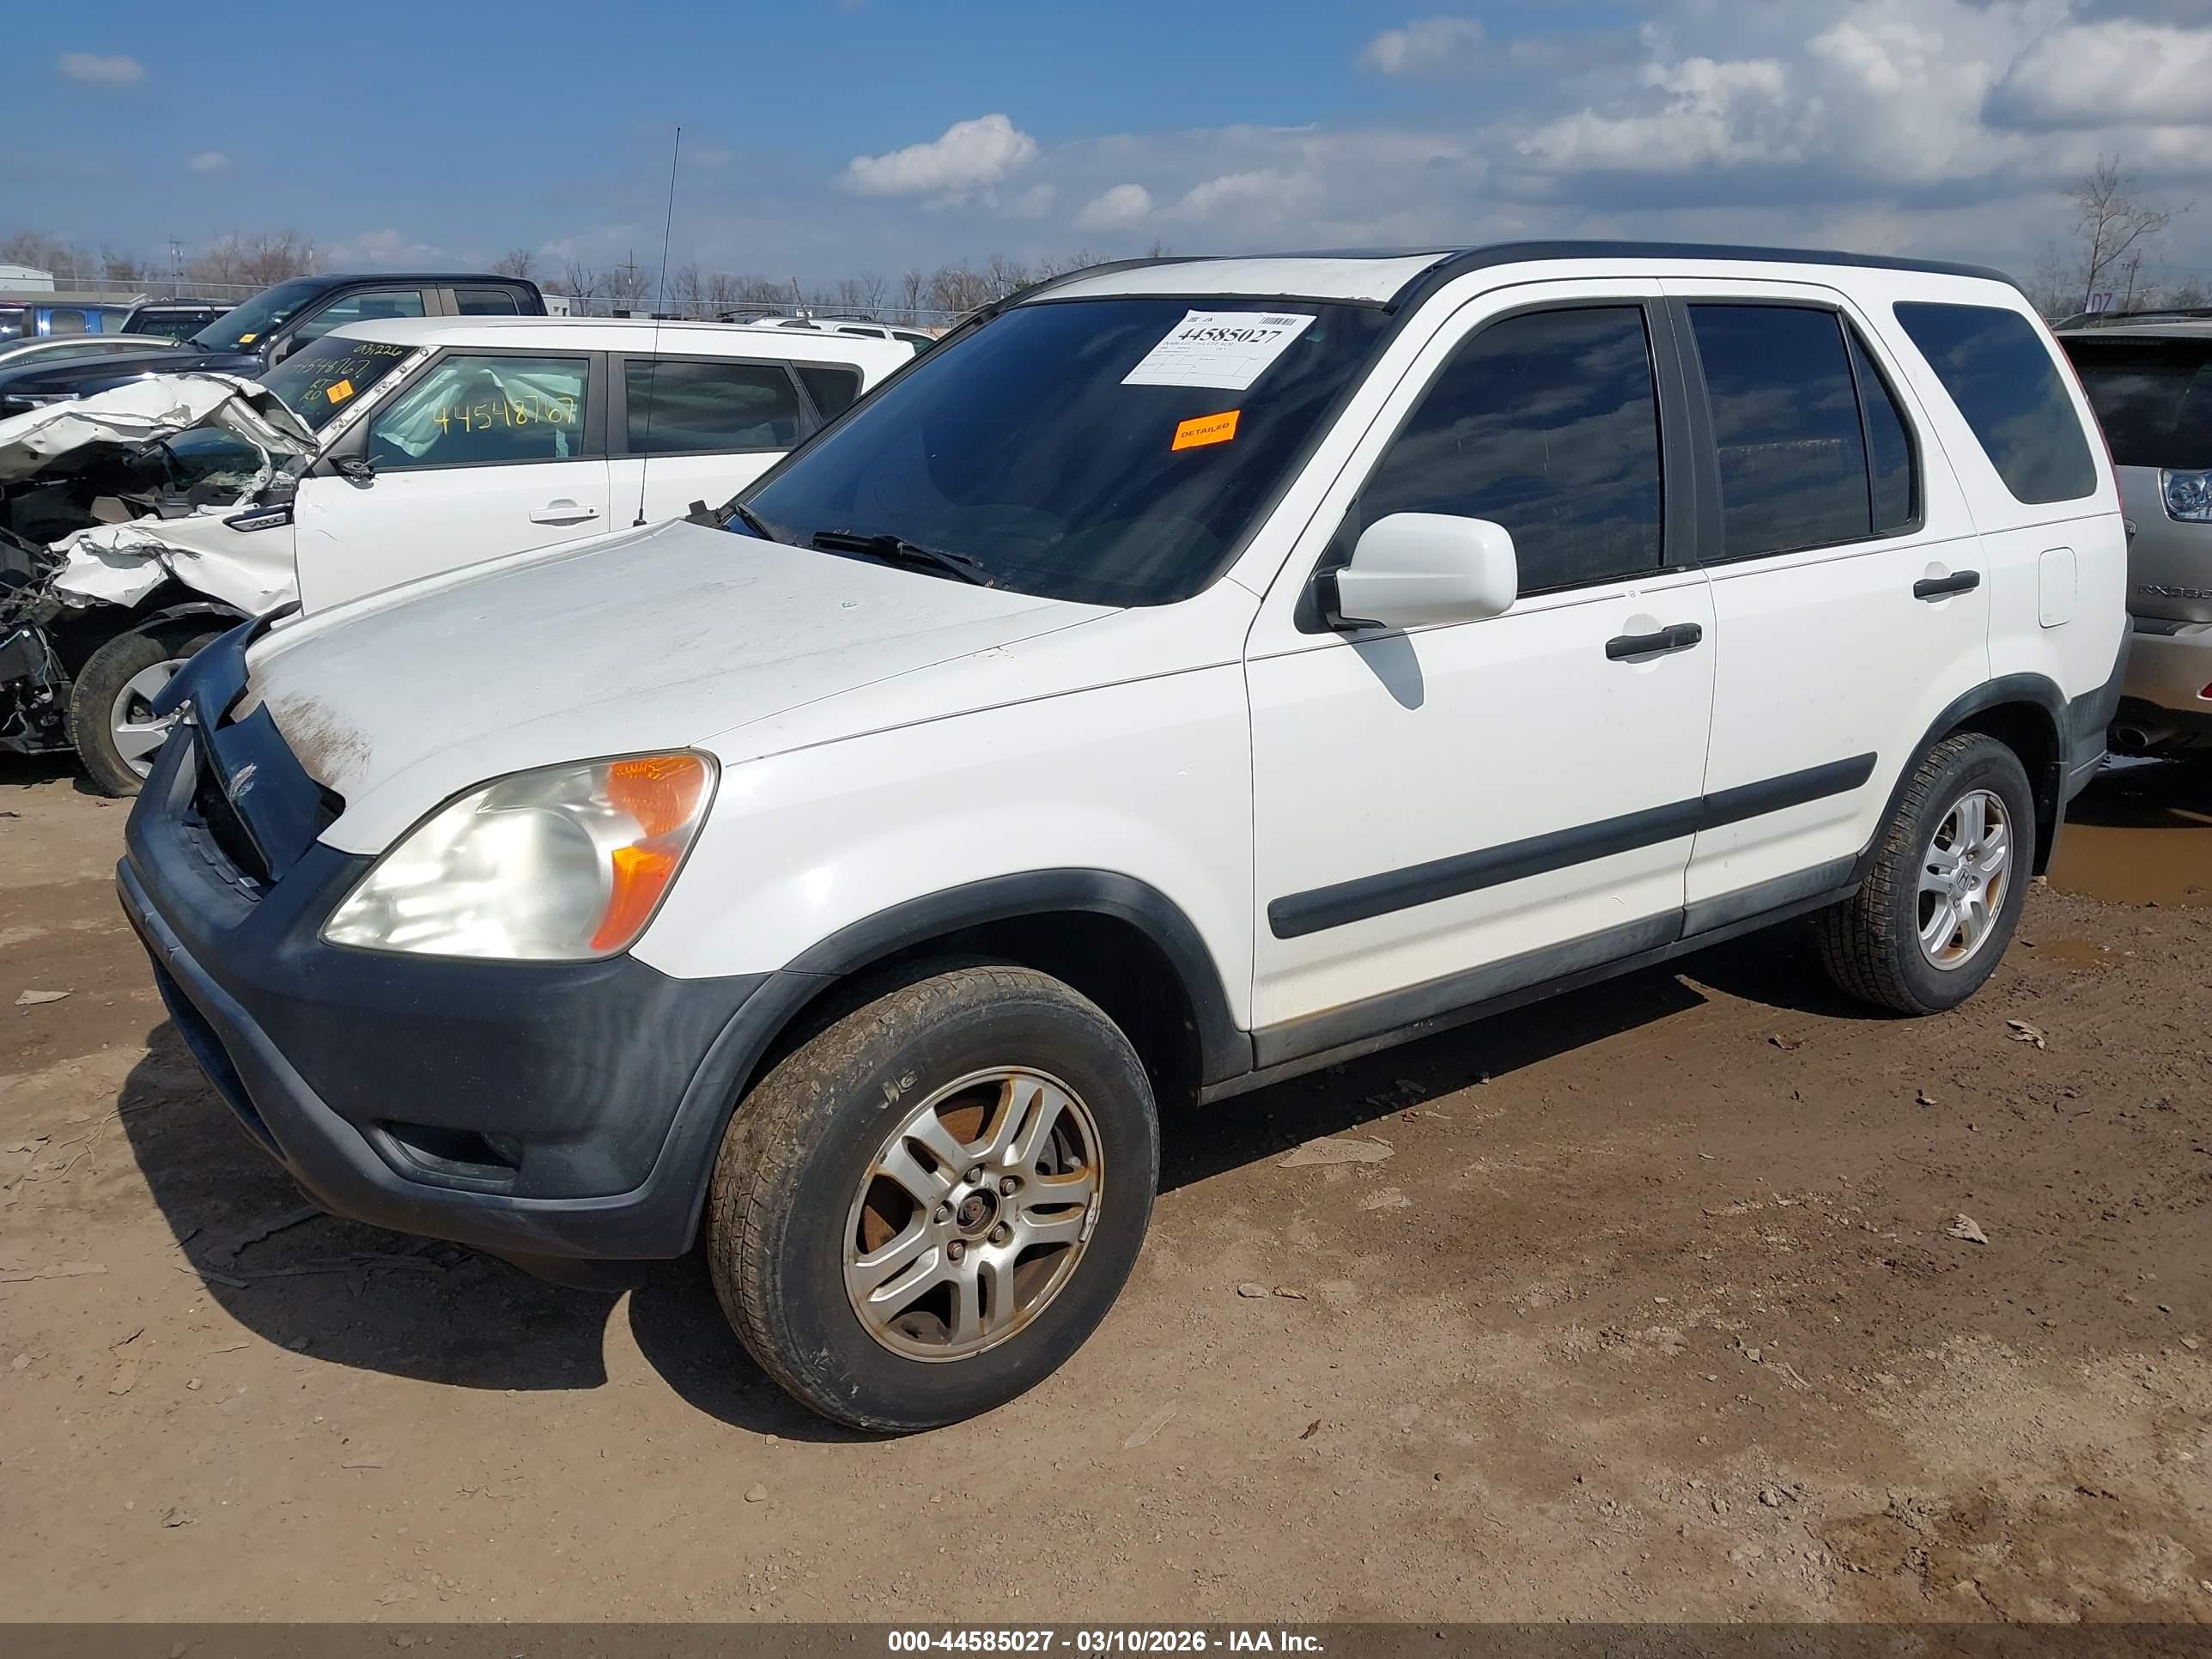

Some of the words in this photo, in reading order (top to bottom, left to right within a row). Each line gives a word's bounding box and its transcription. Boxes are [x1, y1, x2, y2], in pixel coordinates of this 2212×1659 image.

[1177, 328, 1284, 343] 44585027
[434, 395, 574, 434] 44548767
[1181, 422, 1230, 438] DETAILED
